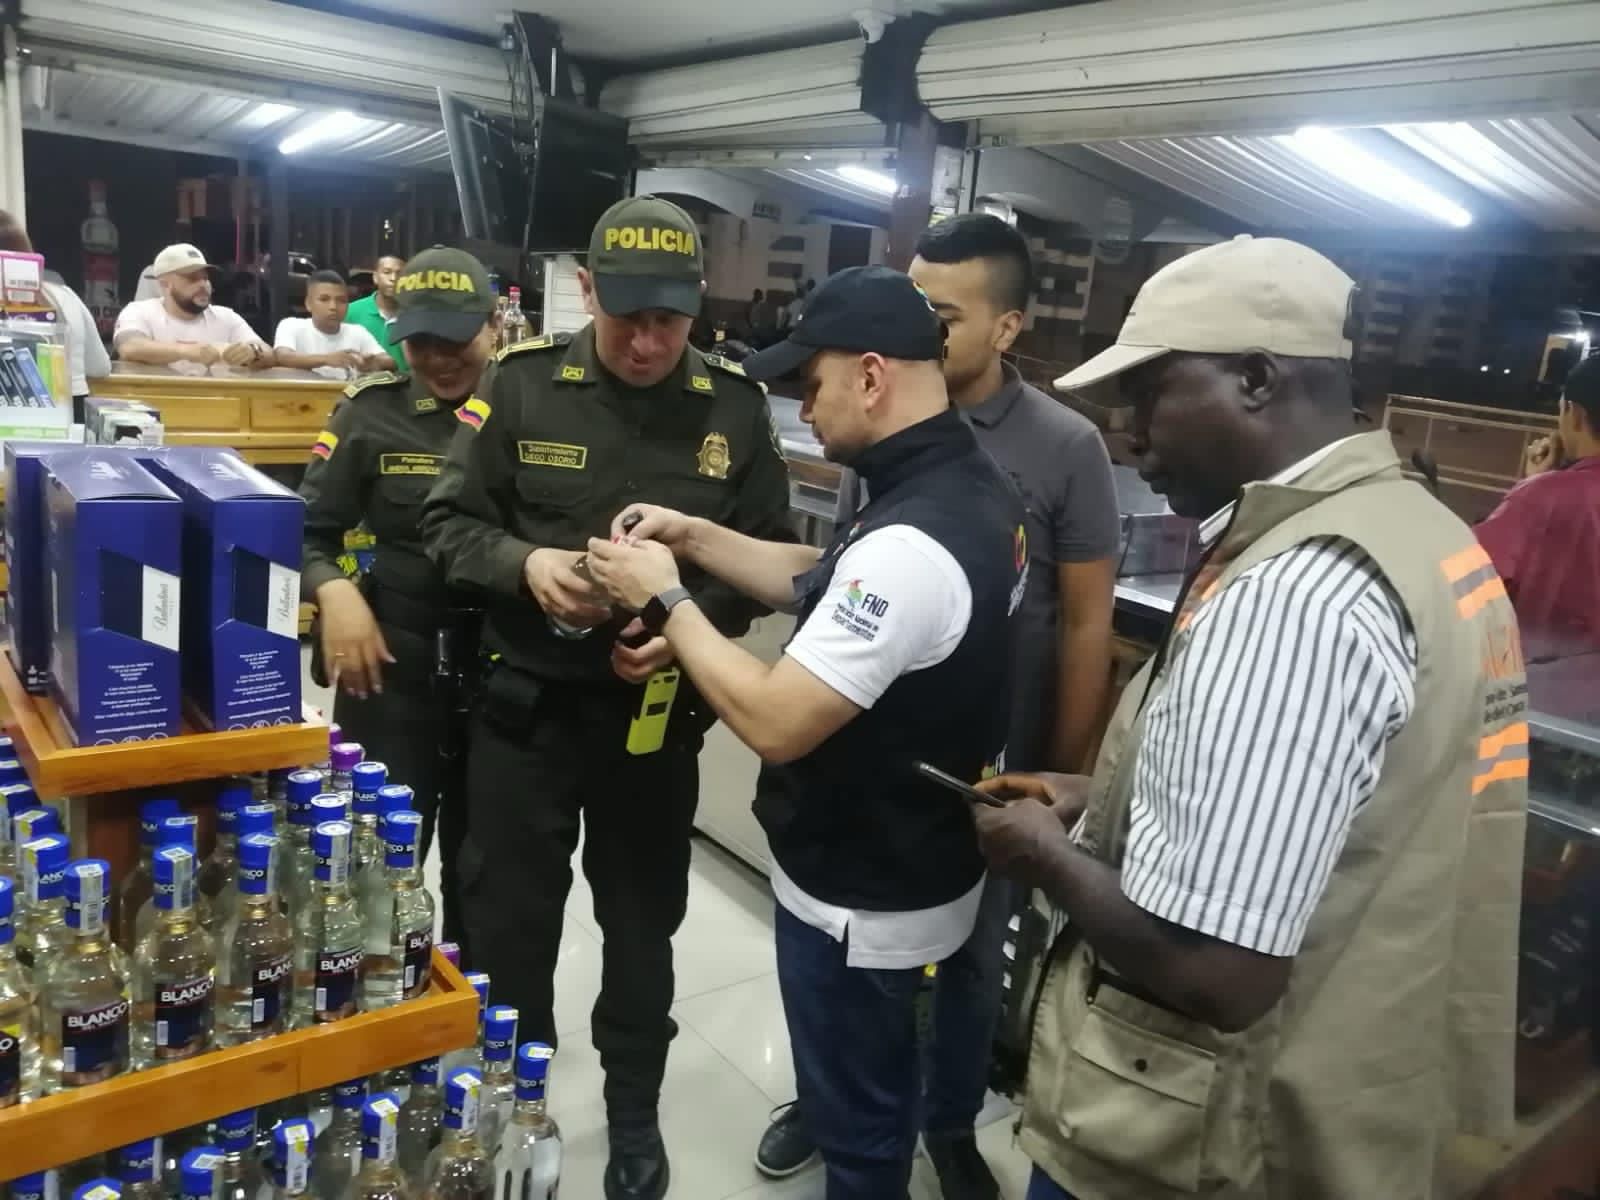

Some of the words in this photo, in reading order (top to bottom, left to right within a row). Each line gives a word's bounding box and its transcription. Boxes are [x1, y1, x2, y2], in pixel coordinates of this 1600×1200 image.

[605, 227, 695, 256] POLICIA
[396, 271, 475, 293] POLICIA
[861, 593, 889, 618] FND
[67, 1002, 128, 1028] BLANCO
